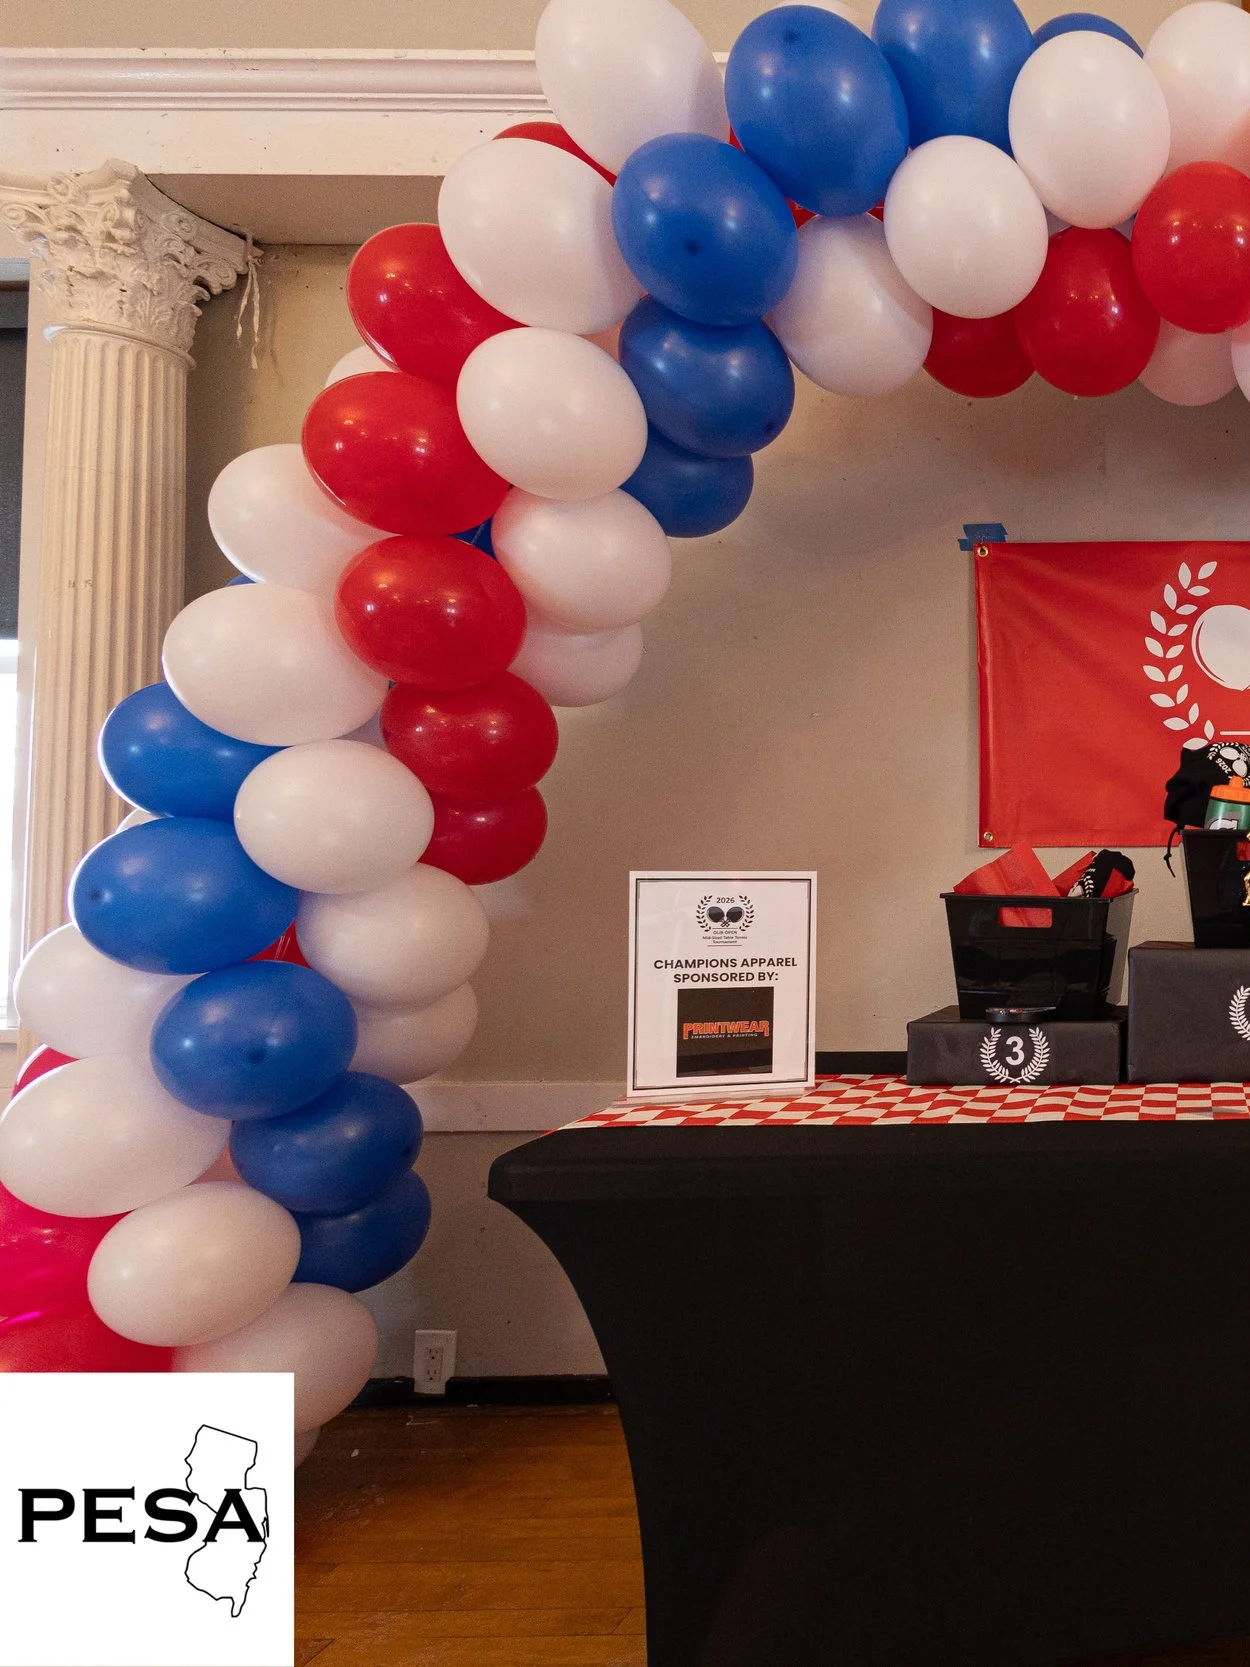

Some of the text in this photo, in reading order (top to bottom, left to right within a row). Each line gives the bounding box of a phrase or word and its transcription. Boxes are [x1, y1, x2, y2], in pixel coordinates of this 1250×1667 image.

[1215, 758, 1232, 774] 2026
[653, 957, 798, 969] CHAMPIONS APPAREL
[673, 971, 779, 983] SPONSORED BY:
[682, 1020, 770, 1040] PRINTWEAR
[1005, 1035, 1025, 1066] 3
